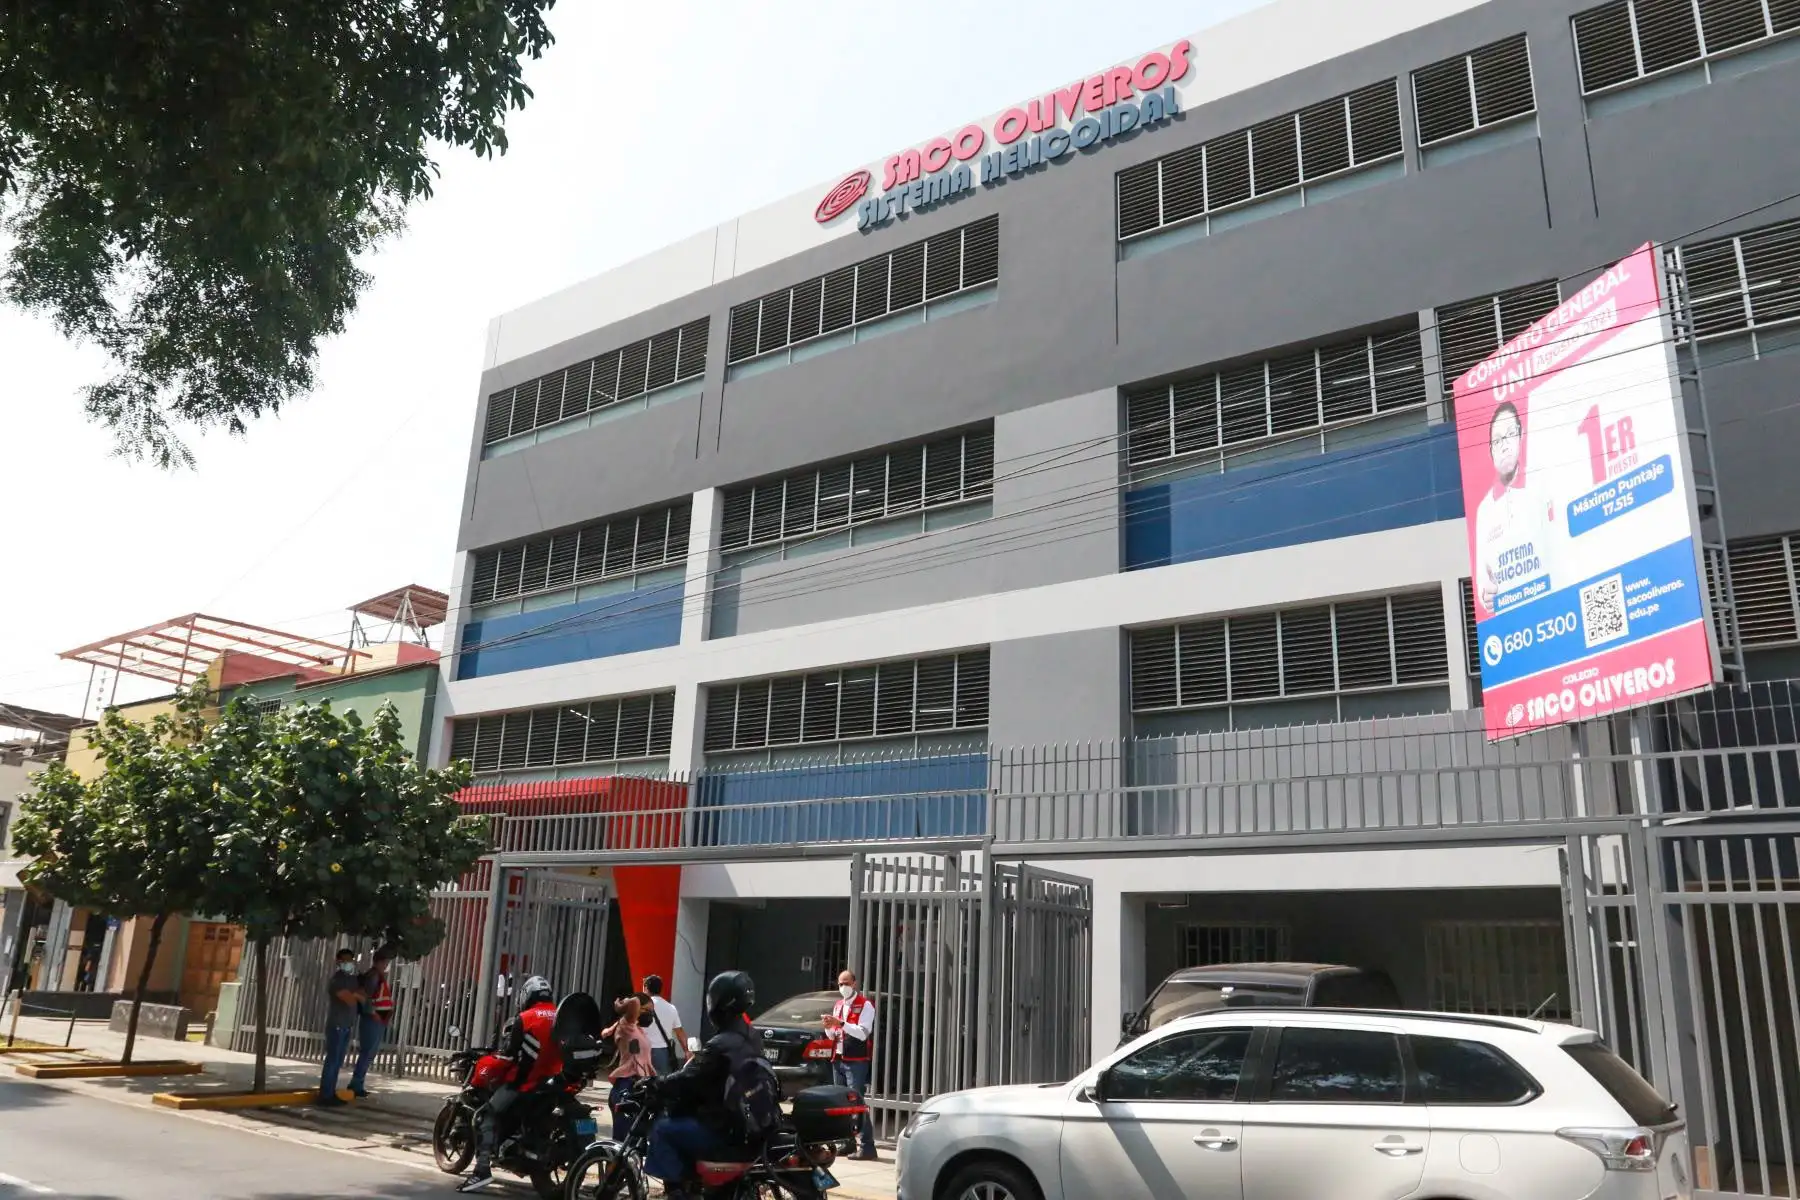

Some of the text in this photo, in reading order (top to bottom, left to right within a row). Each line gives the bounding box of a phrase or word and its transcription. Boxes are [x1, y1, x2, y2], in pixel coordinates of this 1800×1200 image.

[882, 39, 1191, 192] SACO OLIVEROS
[857, 86, 1179, 230] SISTEMA HELICOIDAL
[1546, 264, 1631, 331] GENERAL
[1492, 358, 1532, 401] UNI
[1573, 463, 1665, 516] Máximo Puntaje
[1602, 492, 1635, 517] 17.515
[1498, 542, 1534, 568] SISTEMA
[1498, 581, 1547, 608] Milton Rojas
[1625, 577, 1651, 592] www.
[1627, 579, 1685, 606] sacooliveros.
[1629, 603, 1660, 620] edu.pe
[1504, 611, 1577, 655] 680 5300
[1526, 657, 1676, 722] SACO OLIVEROS
[1562, 667, 1600, 685] COLEGIO
